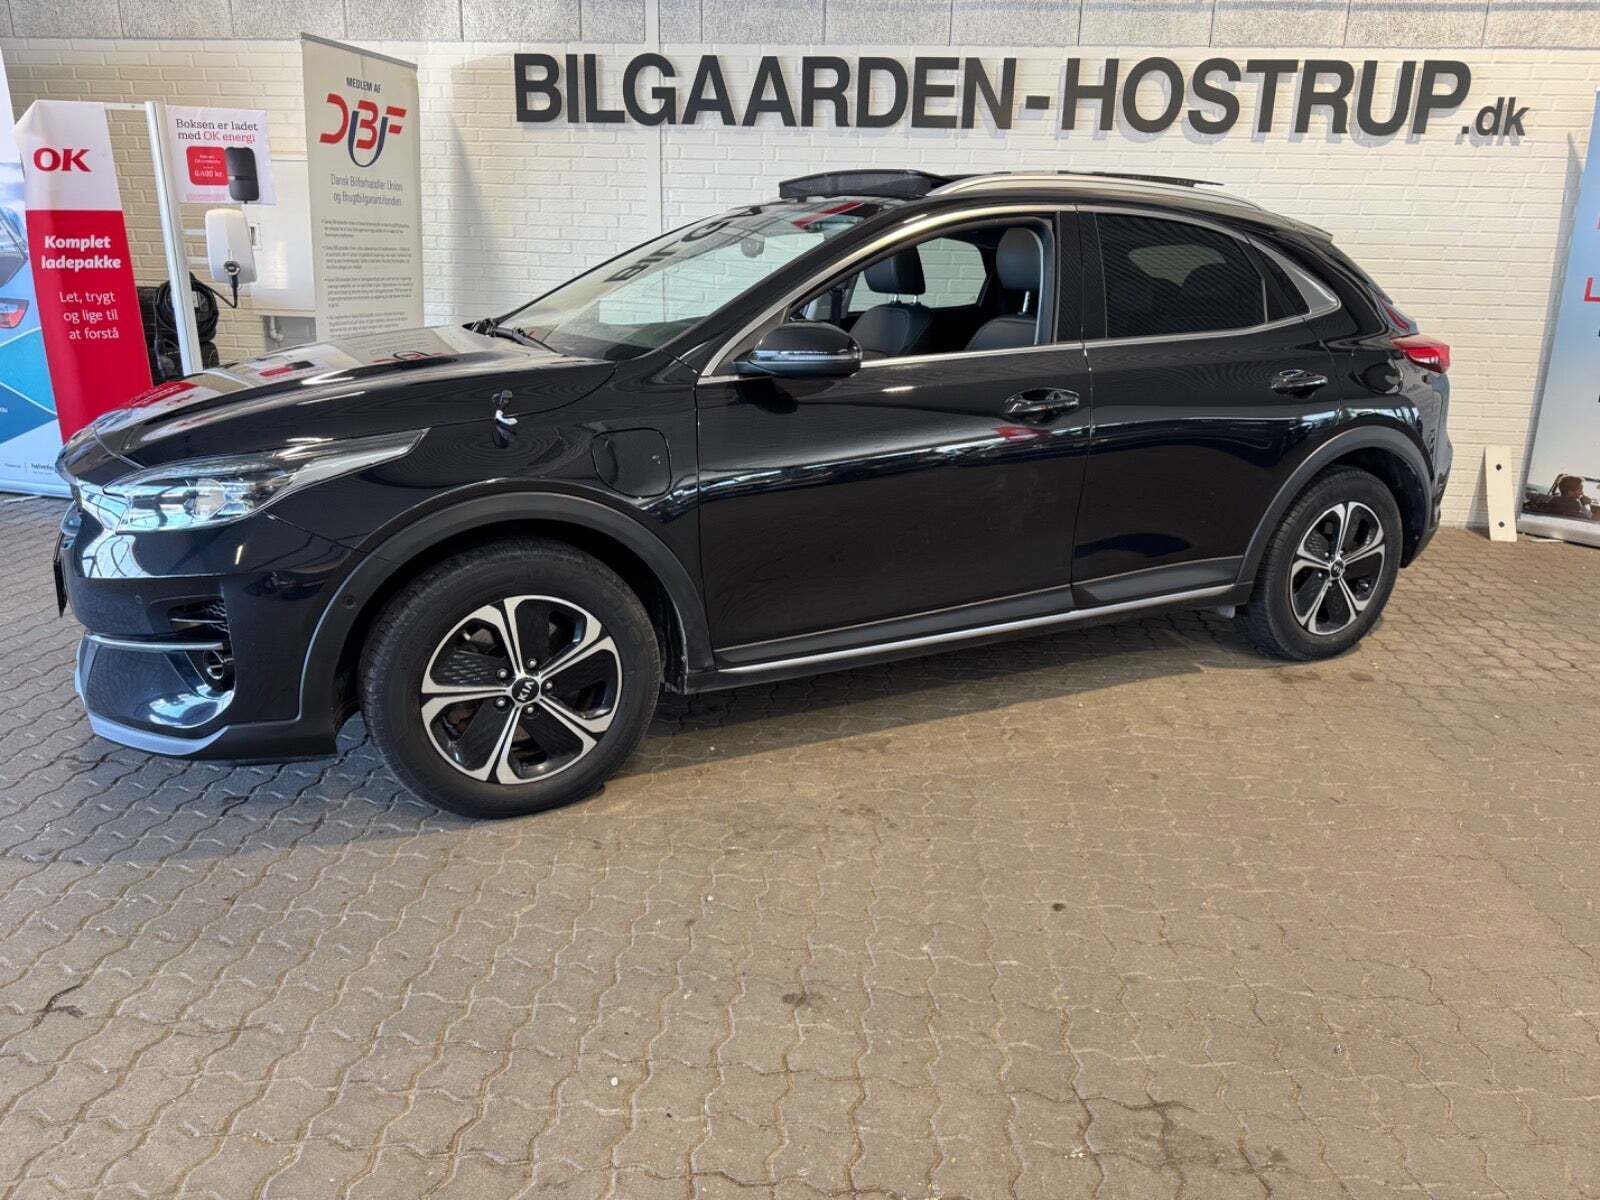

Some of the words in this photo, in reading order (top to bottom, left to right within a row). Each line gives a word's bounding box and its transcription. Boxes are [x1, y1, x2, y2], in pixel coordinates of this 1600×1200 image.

[514, 53, 1530, 137] BILGAARDEN-HOSTRUP.dk
[175, 118, 215, 130] Boksen
[217, 122, 228, 130] er
[231, 121, 259, 131] ladet
[177, 131, 201, 140] med
[203, 131, 220, 141] OK
[222, 133, 256, 144] energi
[33, 147, 91, 172] OK
[44, 234, 111, 252] Komplet
[41, 255, 122, 272] ladepakke
[59, 291, 83, 304] Let,
[85, 291, 116, 305] trygt
[63, 312, 80, 325] og
[82, 309, 103, 324] lige
[106, 309, 119, 321] til
[69, 329, 82, 340] at
[84, 326, 120, 340] forstå
[517, 681, 535, 701] KIA
